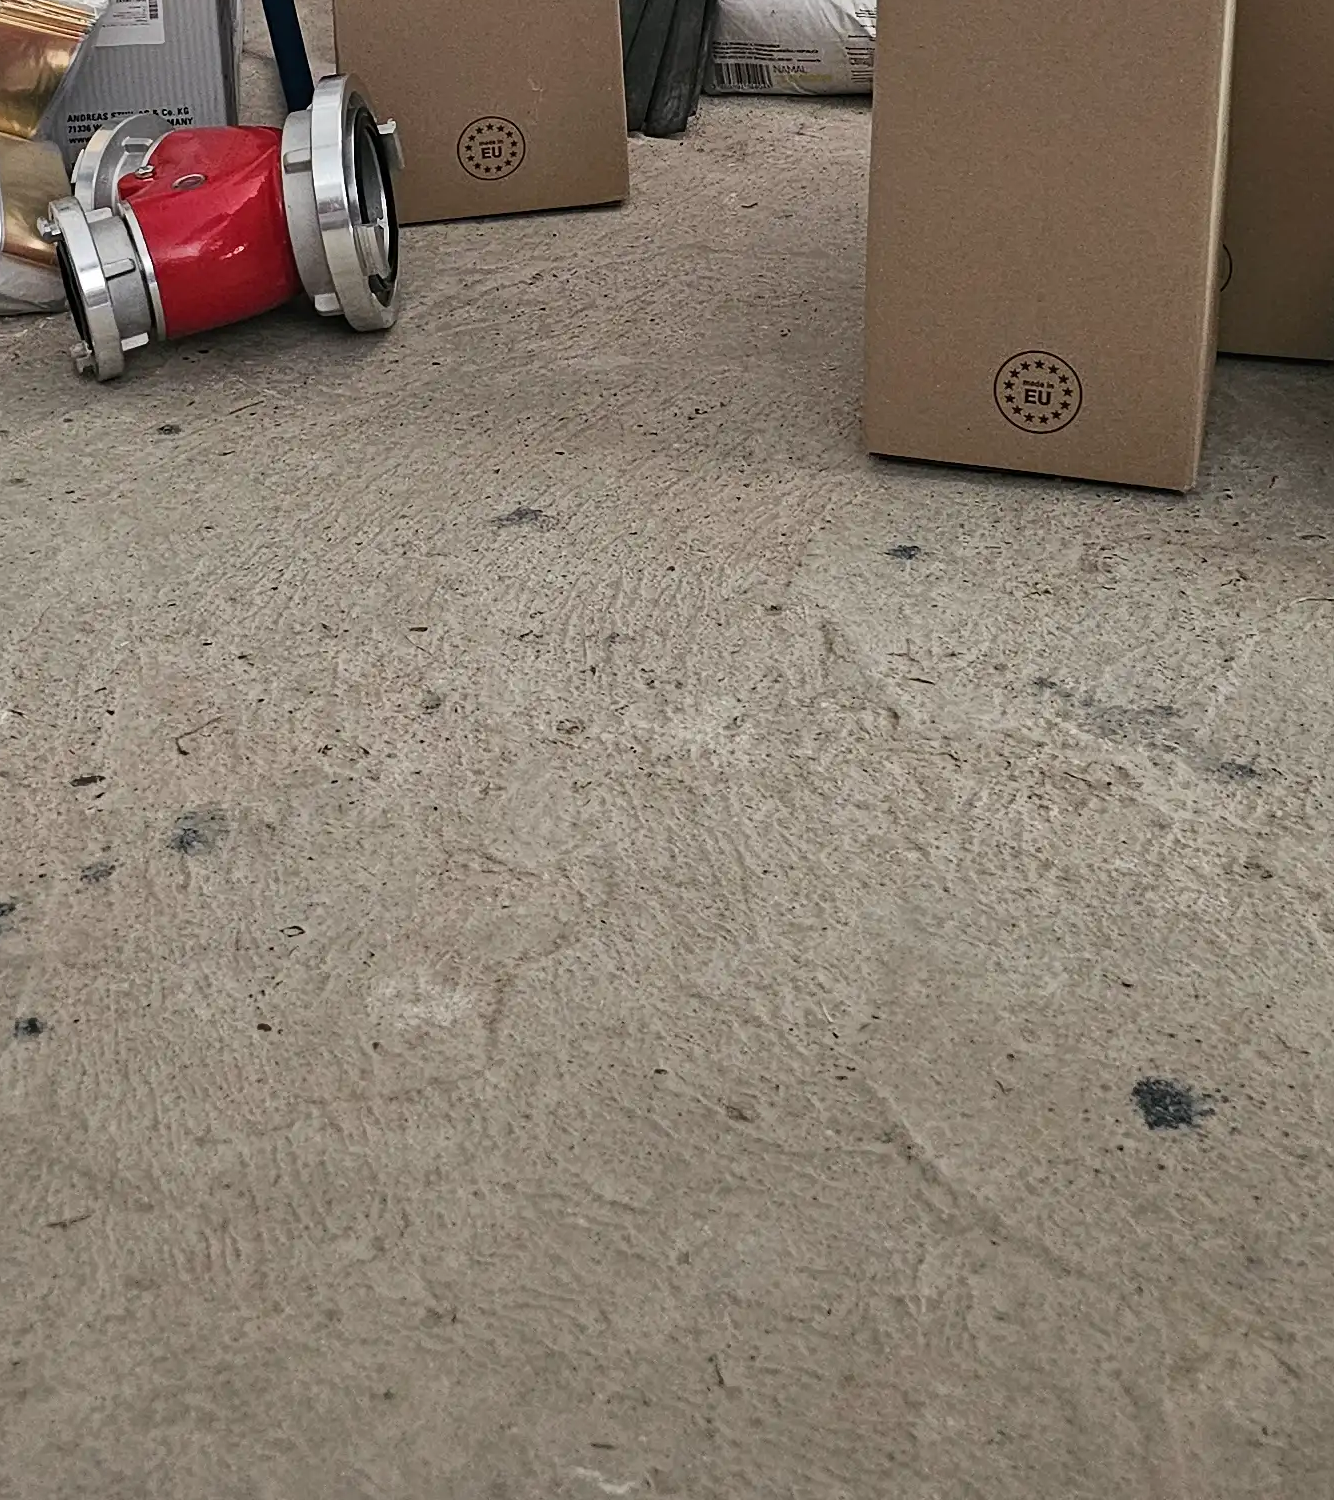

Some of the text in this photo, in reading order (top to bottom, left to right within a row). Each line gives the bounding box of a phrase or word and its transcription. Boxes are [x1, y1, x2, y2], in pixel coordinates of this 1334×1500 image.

[67, 112, 109, 123] ANDREAS
[480, 145, 502, 159] EU
[1024, 388, 1052, 406] EU
